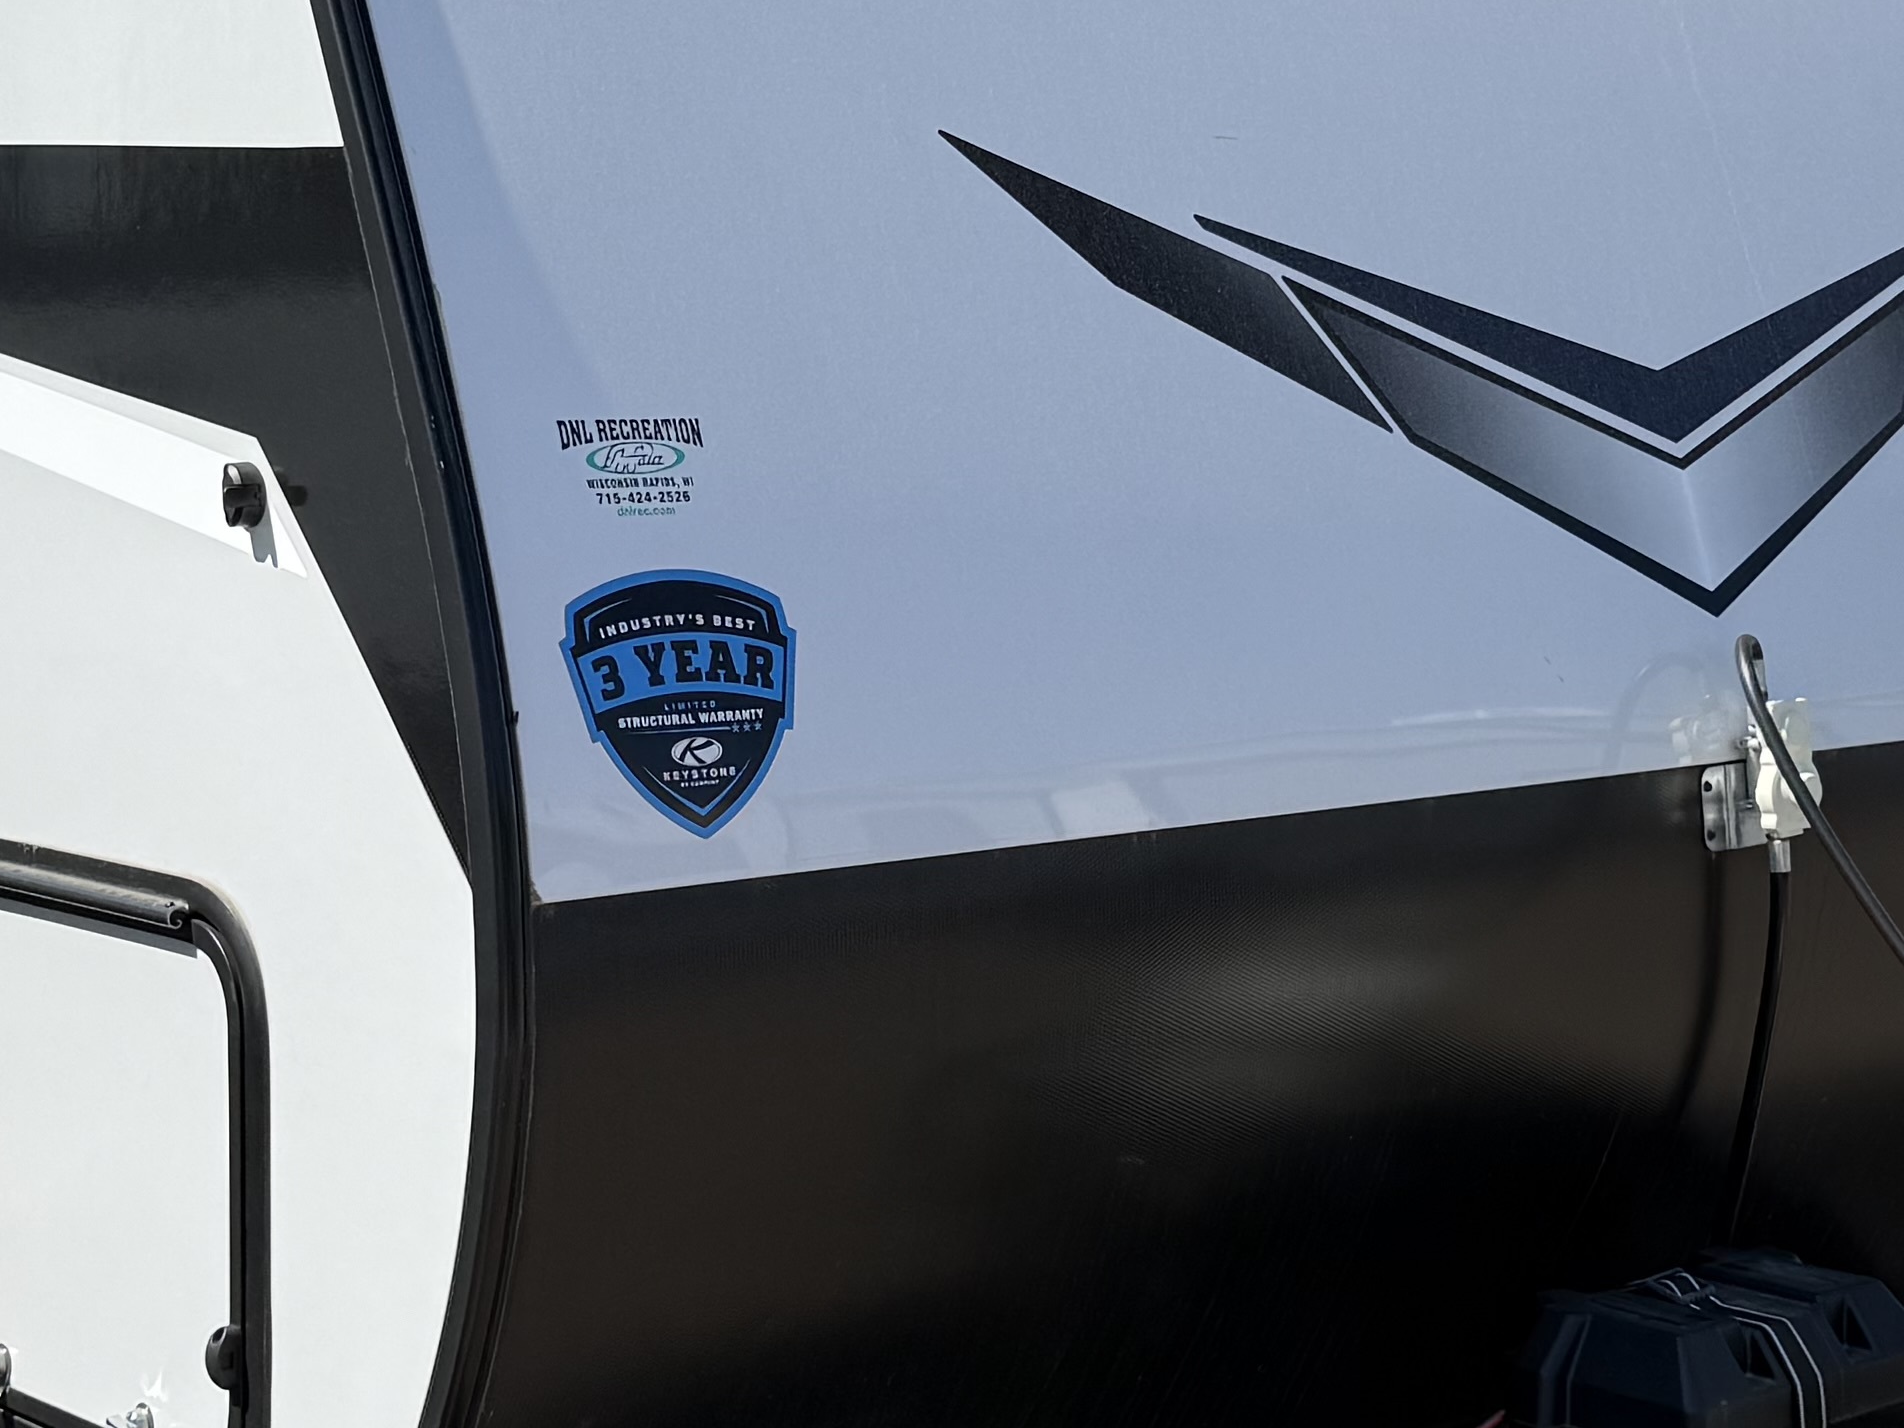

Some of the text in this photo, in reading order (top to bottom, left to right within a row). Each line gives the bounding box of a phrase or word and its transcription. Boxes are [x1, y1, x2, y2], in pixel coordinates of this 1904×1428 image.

[556, 417, 704, 450] DNL RECREATION
[595, 490, 692, 505] 715-424-2526
[598, 613, 757, 640] INDUSTRY'S BEST
[591, 638, 776, 702] 3 YEAR
[617, 707, 765, 729] STRUCTURAL WARRANTY
